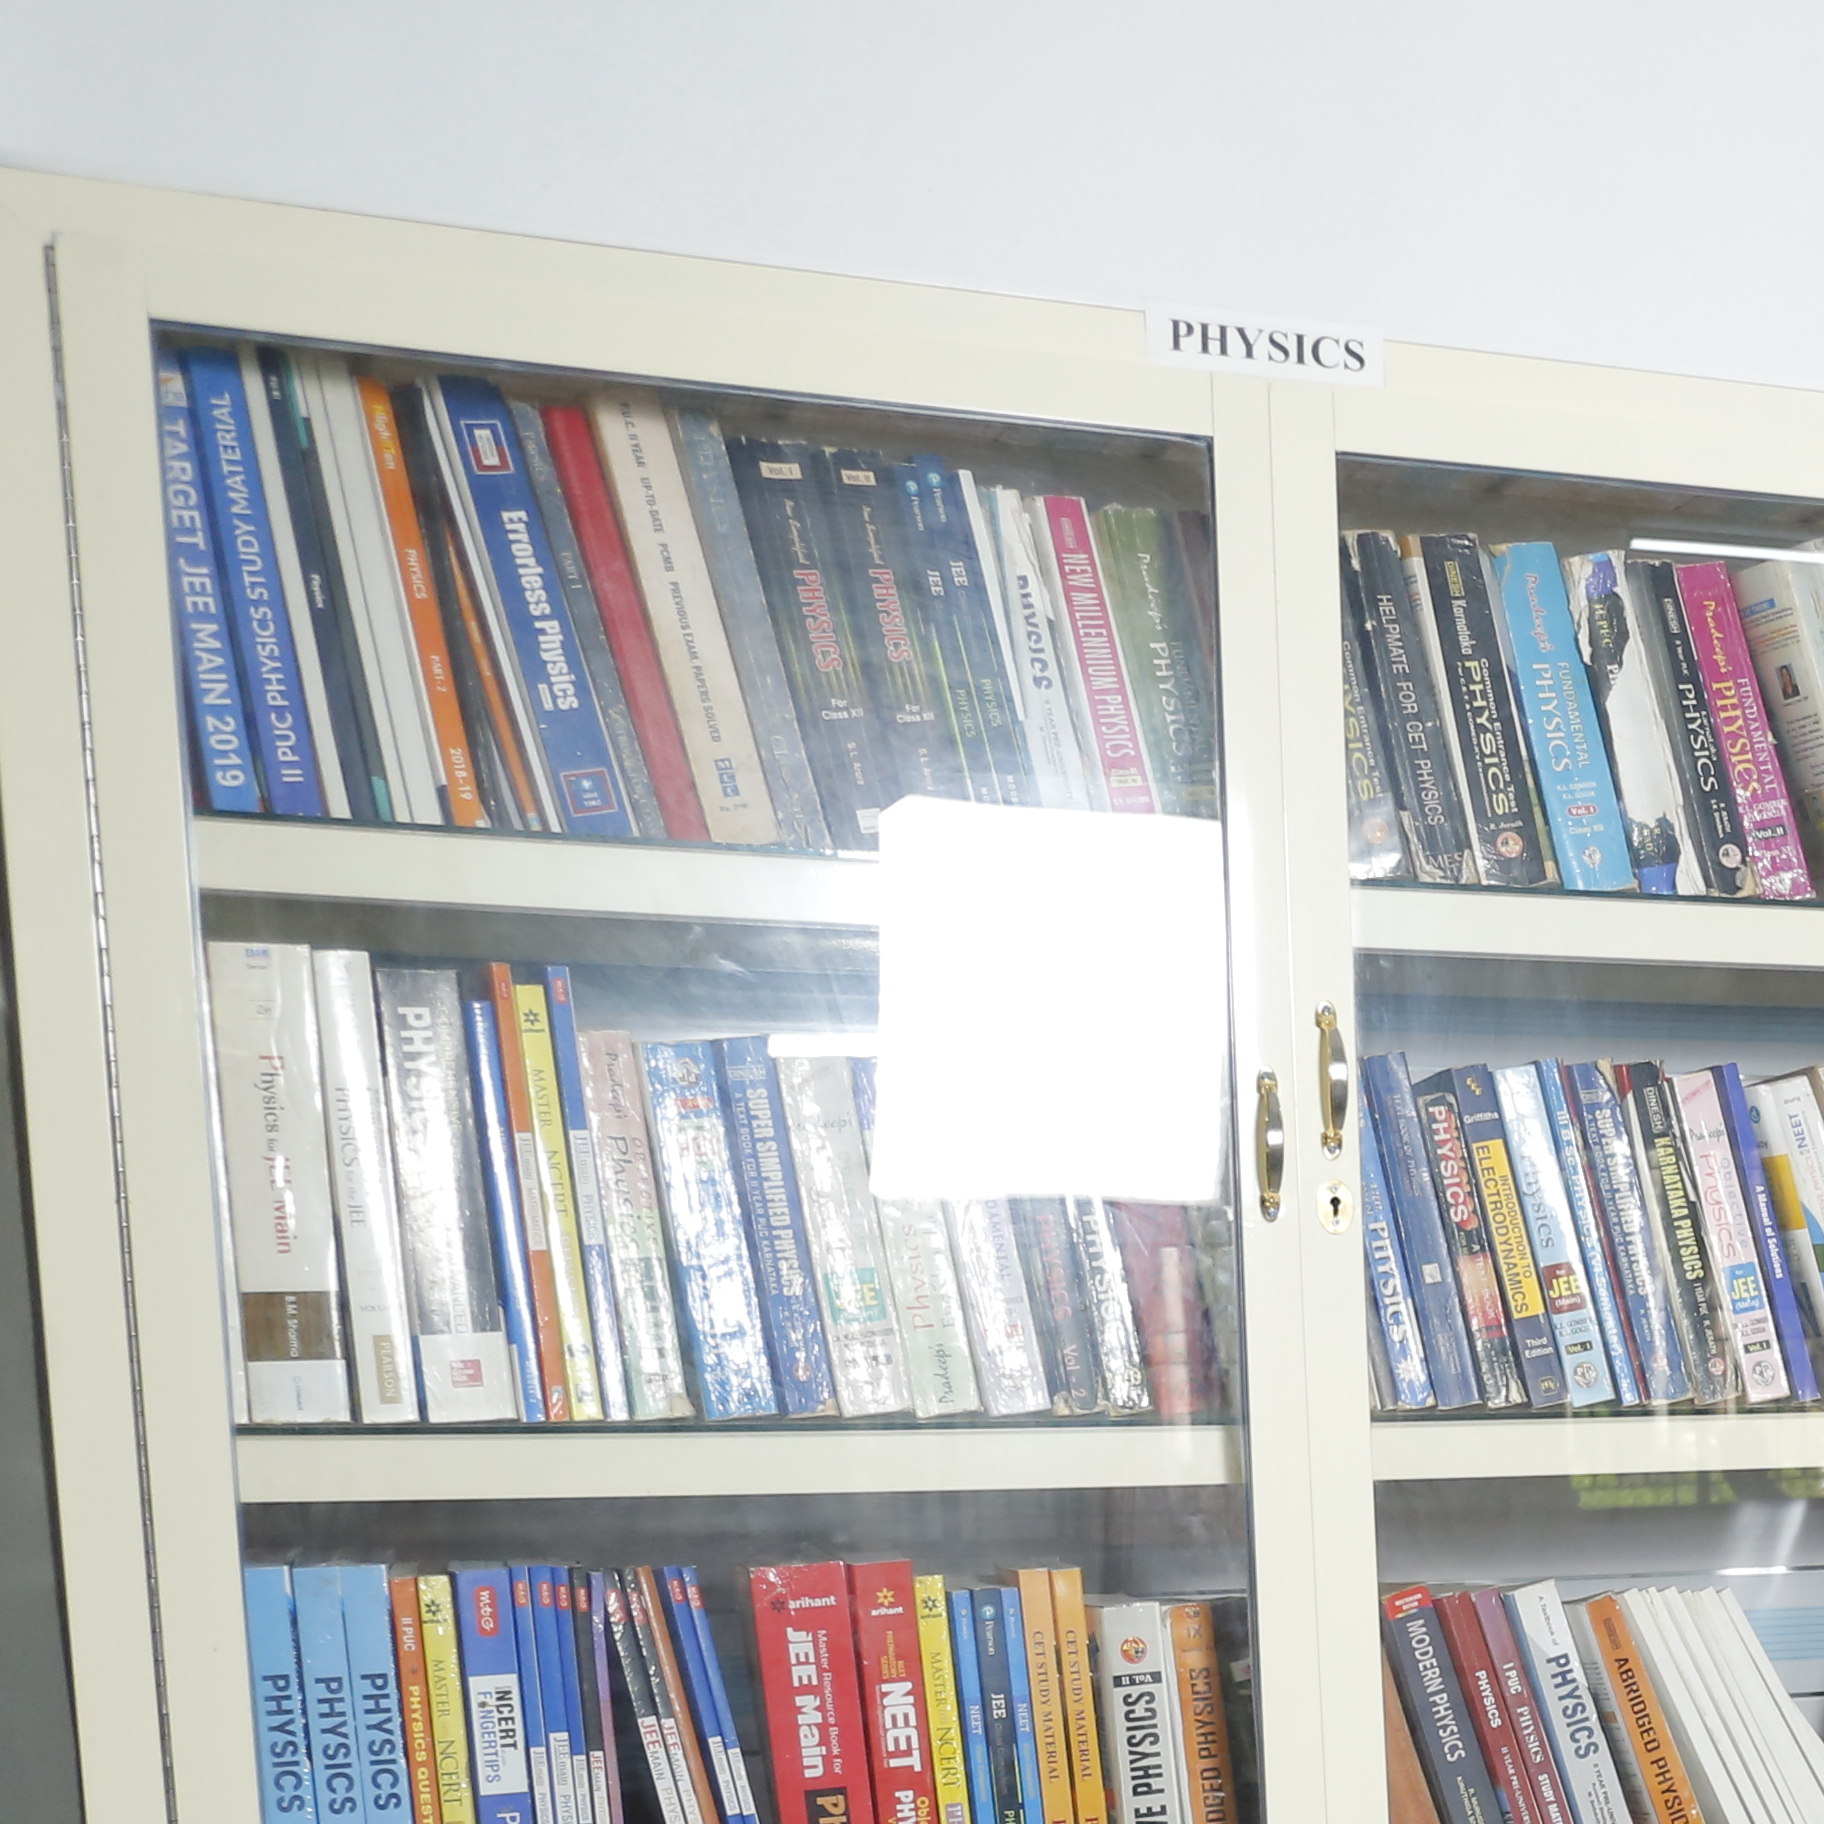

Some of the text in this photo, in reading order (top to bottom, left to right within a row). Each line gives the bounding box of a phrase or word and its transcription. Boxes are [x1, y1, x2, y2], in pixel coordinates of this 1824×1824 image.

[1169, 318, 1366, 372] PHYSICS
[209, 389, 252, 523] MATERIAL
[163, 419, 244, 788] TARGET JEE MAIN 2019
[233, 520, 269, 602] STUDY
[501, 509, 578, 711] Errorless Physics
[248, 607, 283, 707] PHYSICS
[793, 570, 843, 672] PHYSICS
[265, 710, 296, 766] PUC
[1464, 659, 1510, 817] PHYSICS
[1558, 662, 1591, 771] FUNDAMENTAL
[1463, 1109, 1500, 1124] Griffiths
[904, 1223, 935, 1331] Physics
[1368, 1219, 1410, 1347] PHYSICS
[1475, 1142, 1531, 1316] ELECTRODYNAMICS
[789, 1595, 837, 1610] arihant
[262, 1673, 304, 1814] PHYSICS
[407, 1684, 427, 1763] PHYSICS
[786, 1627, 826, 1779] JEE Main
[881, 1681, 923, 1771] NEET
[1122, 1689, 1162, 1797] PHYSICS
[1192, 1666, 1221, 1760] PHYSICS
[1406, 1618, 1467, 1763] MODERN PHYSICS
[1545, 1652, 1599, 1761] PHYSICS
[1612, 1656, 1654, 1753] ABRIDGED
